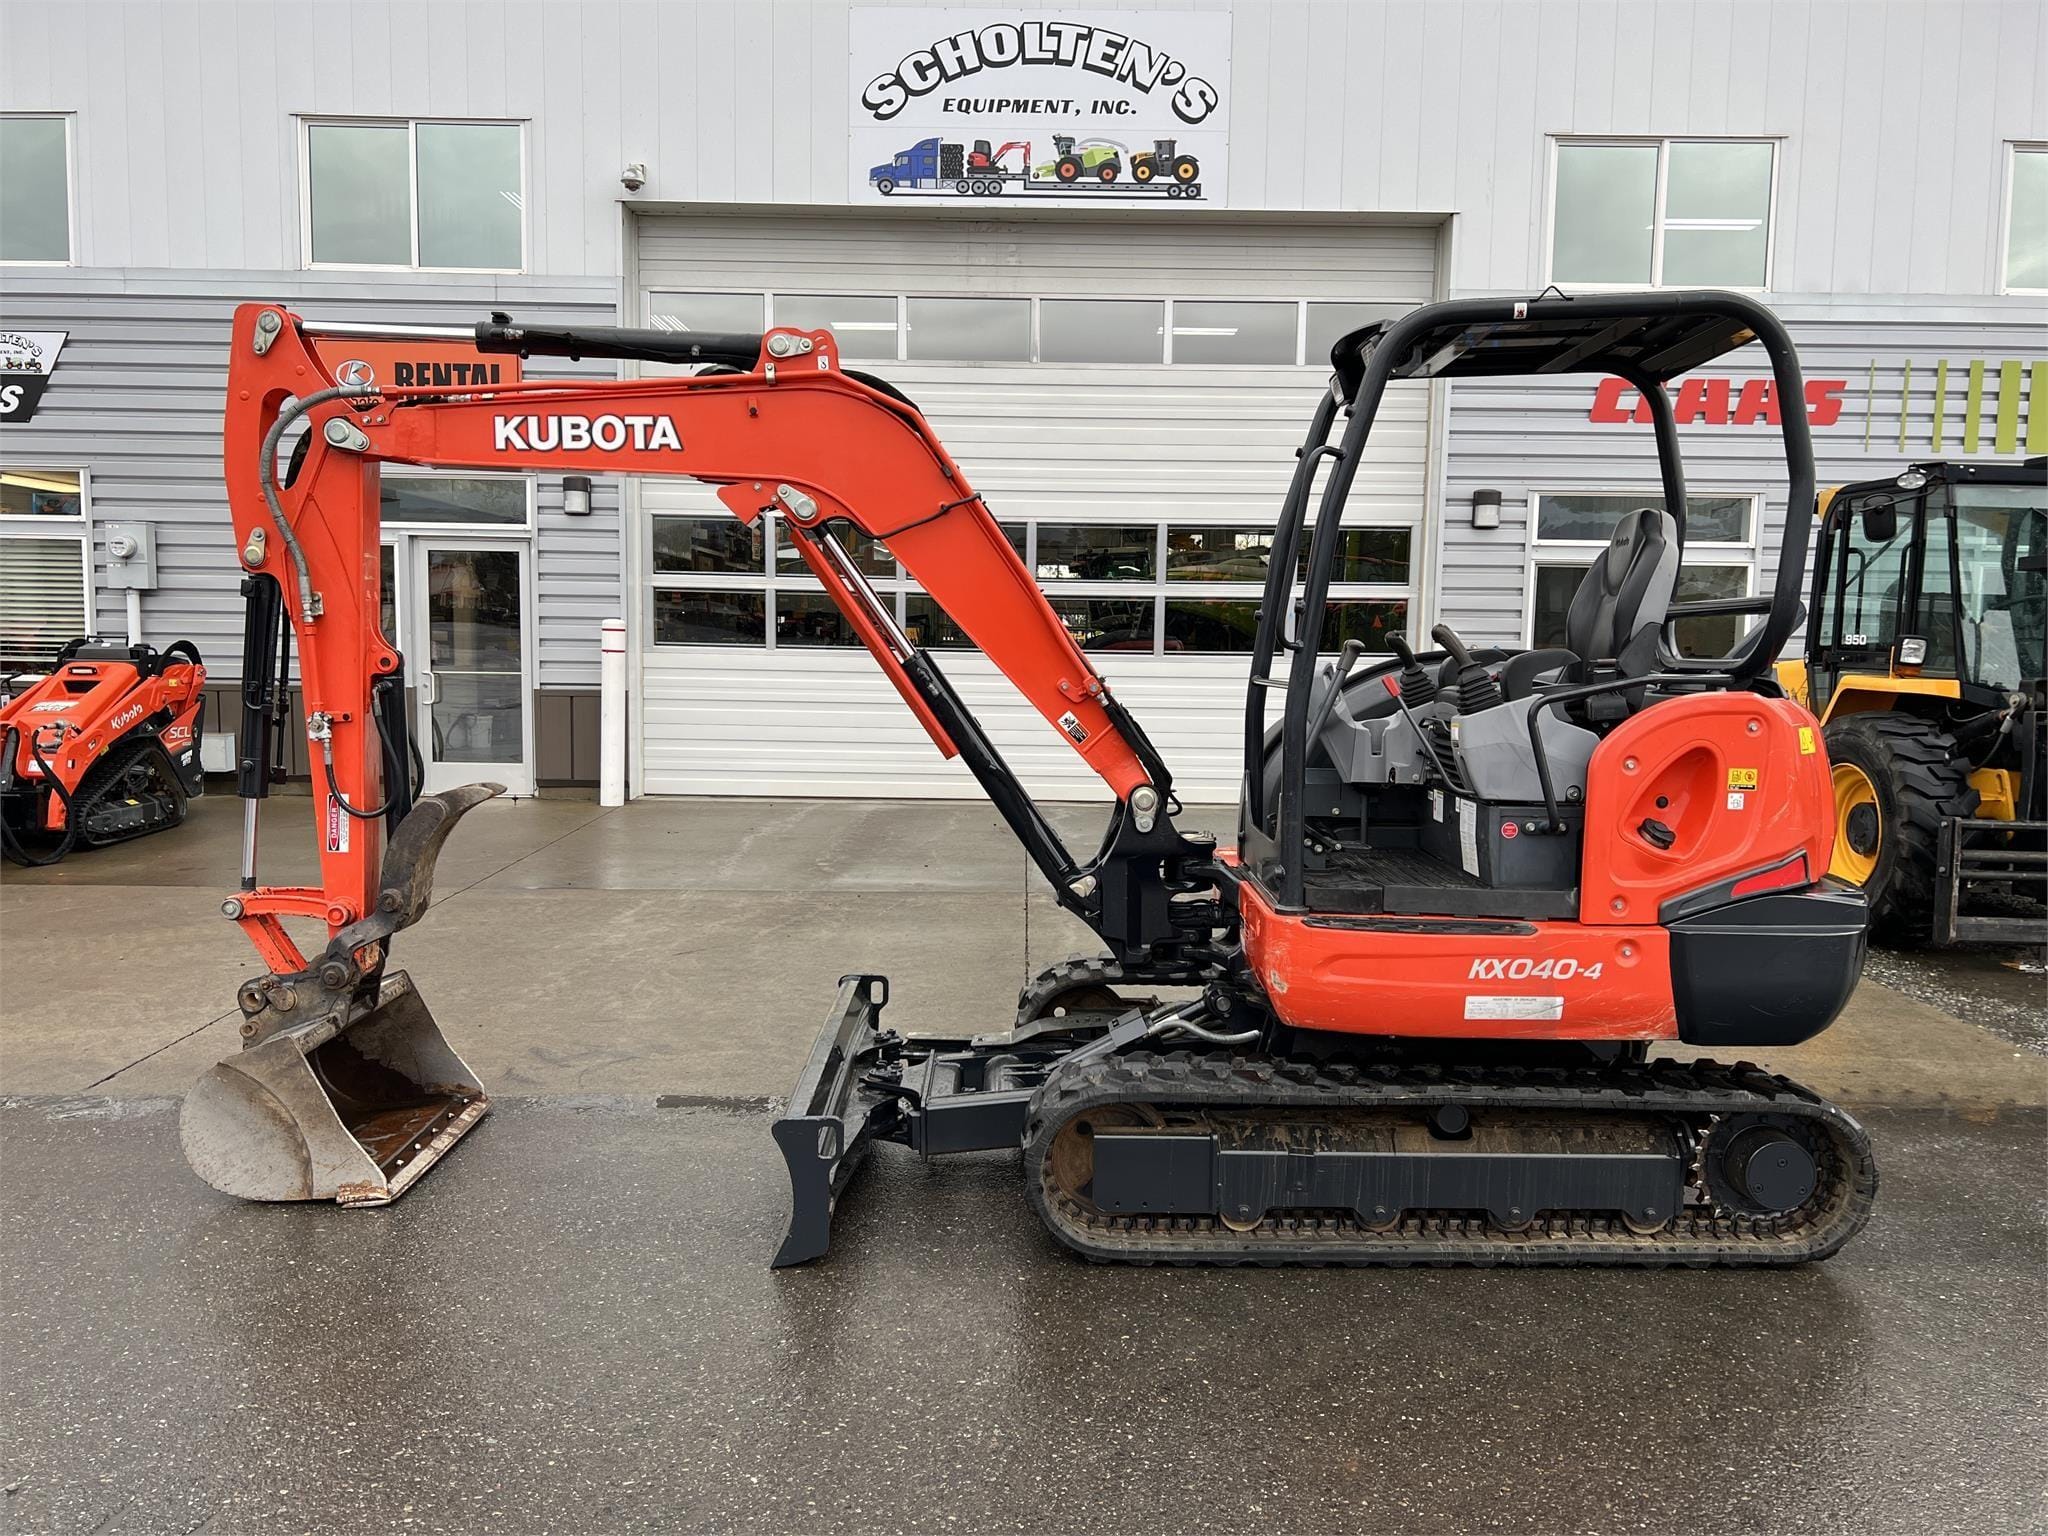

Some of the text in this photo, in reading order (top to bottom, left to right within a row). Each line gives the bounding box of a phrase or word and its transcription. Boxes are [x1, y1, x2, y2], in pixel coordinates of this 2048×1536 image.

[862, 21, 1219, 125] SCHOLTEN'S
[942, 98, 1137, 116] EQUIPMENT, INC.
[0, 384, 24, 413] S
[493, 414, 683, 451] KUBOTA
[1845, 634, 1867, 645] 950
[110, 703, 143, 730] Kubota
[168, 726, 191, 739] SCL
[1467, 958, 1604, 980] KX040-4
